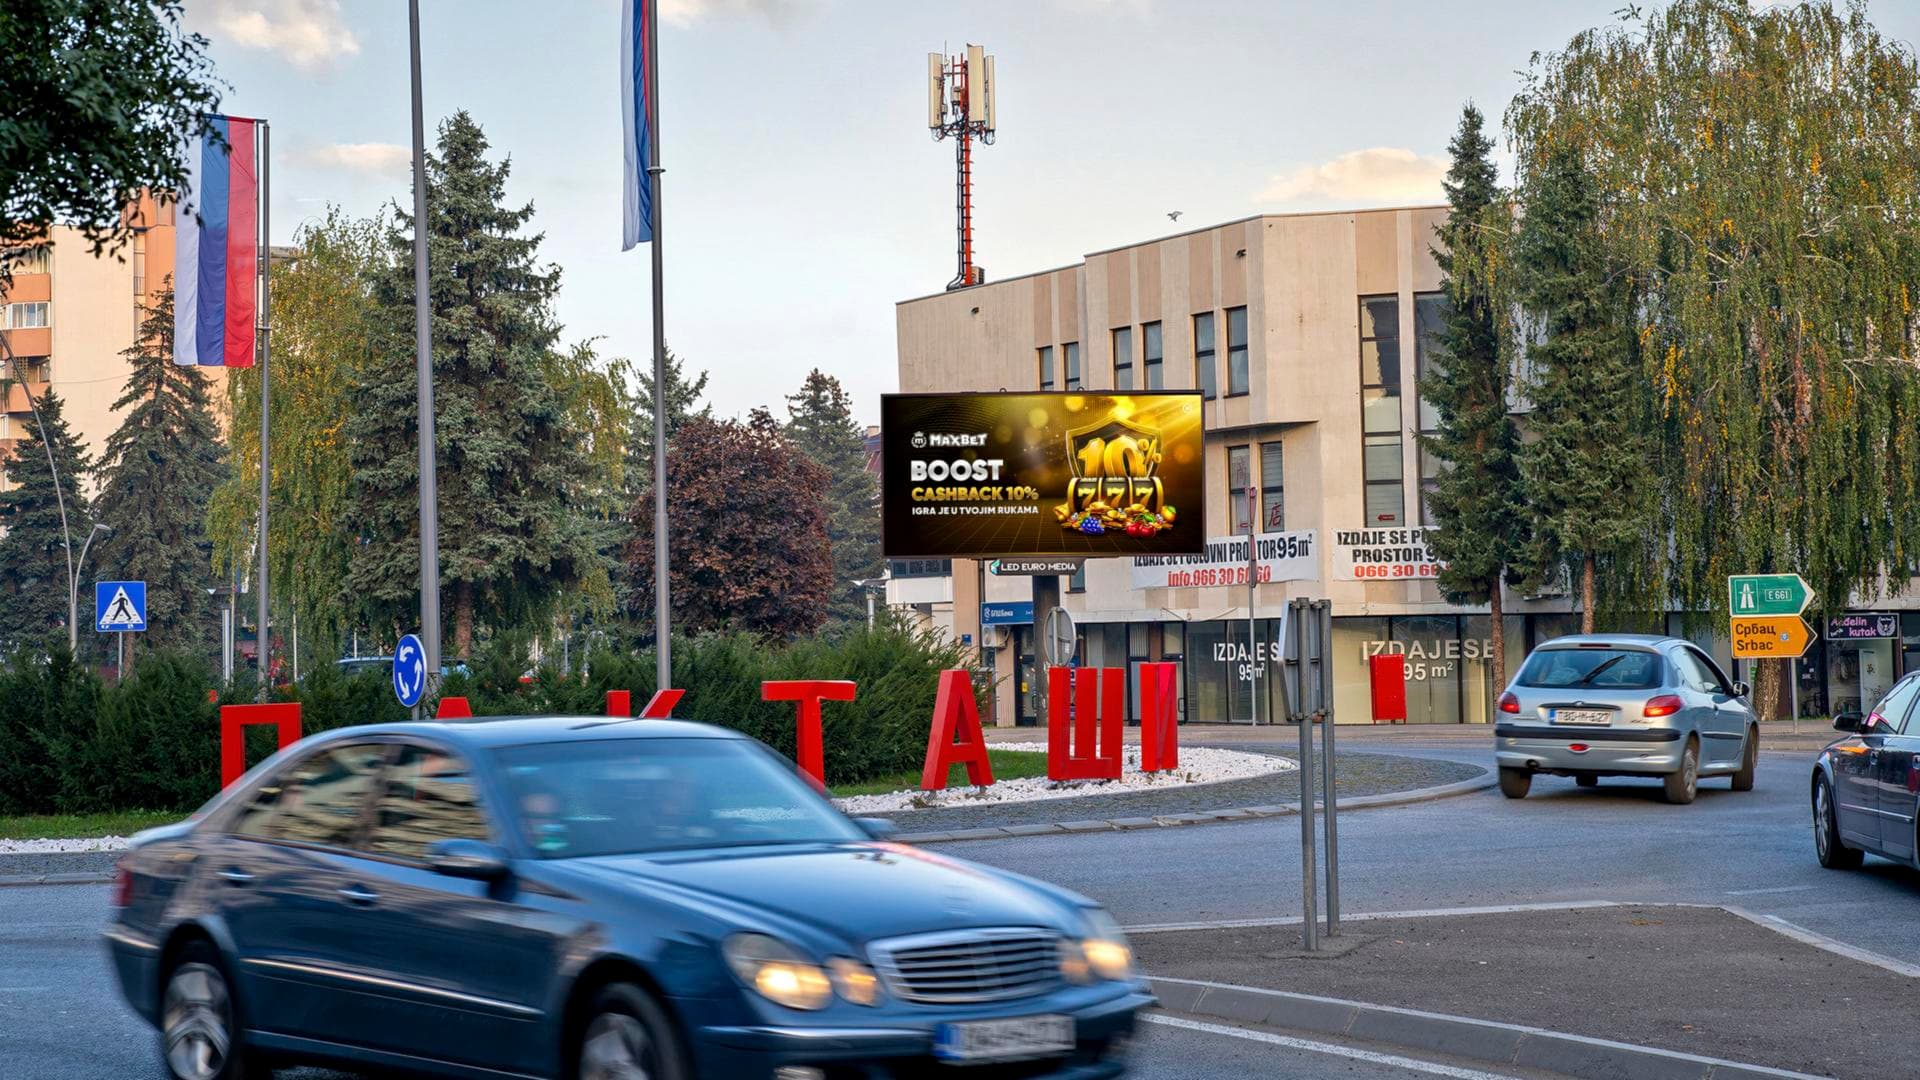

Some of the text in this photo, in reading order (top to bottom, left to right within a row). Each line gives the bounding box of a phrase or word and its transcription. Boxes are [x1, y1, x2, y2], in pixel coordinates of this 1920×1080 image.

[911, 459, 1004, 481] BOOST
[911, 486, 1039, 501] CASHBACK 10%
[912, 506, 1039, 515] IGRA JE U TVOJIM RUKAMA
[1337, 531, 1386, 546] IZDAJE
[1389, 530, 1408, 545] SE
[1229, 540, 1277, 562] PROTOR
[1352, 548, 1423, 563] PROSTOR
[1001, 563, 1077, 571] LED EURO MEDIA
[1354, 565, 1388, 577] 066
[1392, 564, 1415, 577] 30
[1219, 567, 1234, 585] 30
[1775, 592, 1788, 600] 661
[1736, 623, 1776, 637] Србац
[1849, 627, 1877, 637] kutak
[1213, 642, 1266, 662] IZDAE
[1737, 640, 1773, 651] Srbac
[1404, 662, 1427, 681] 95
